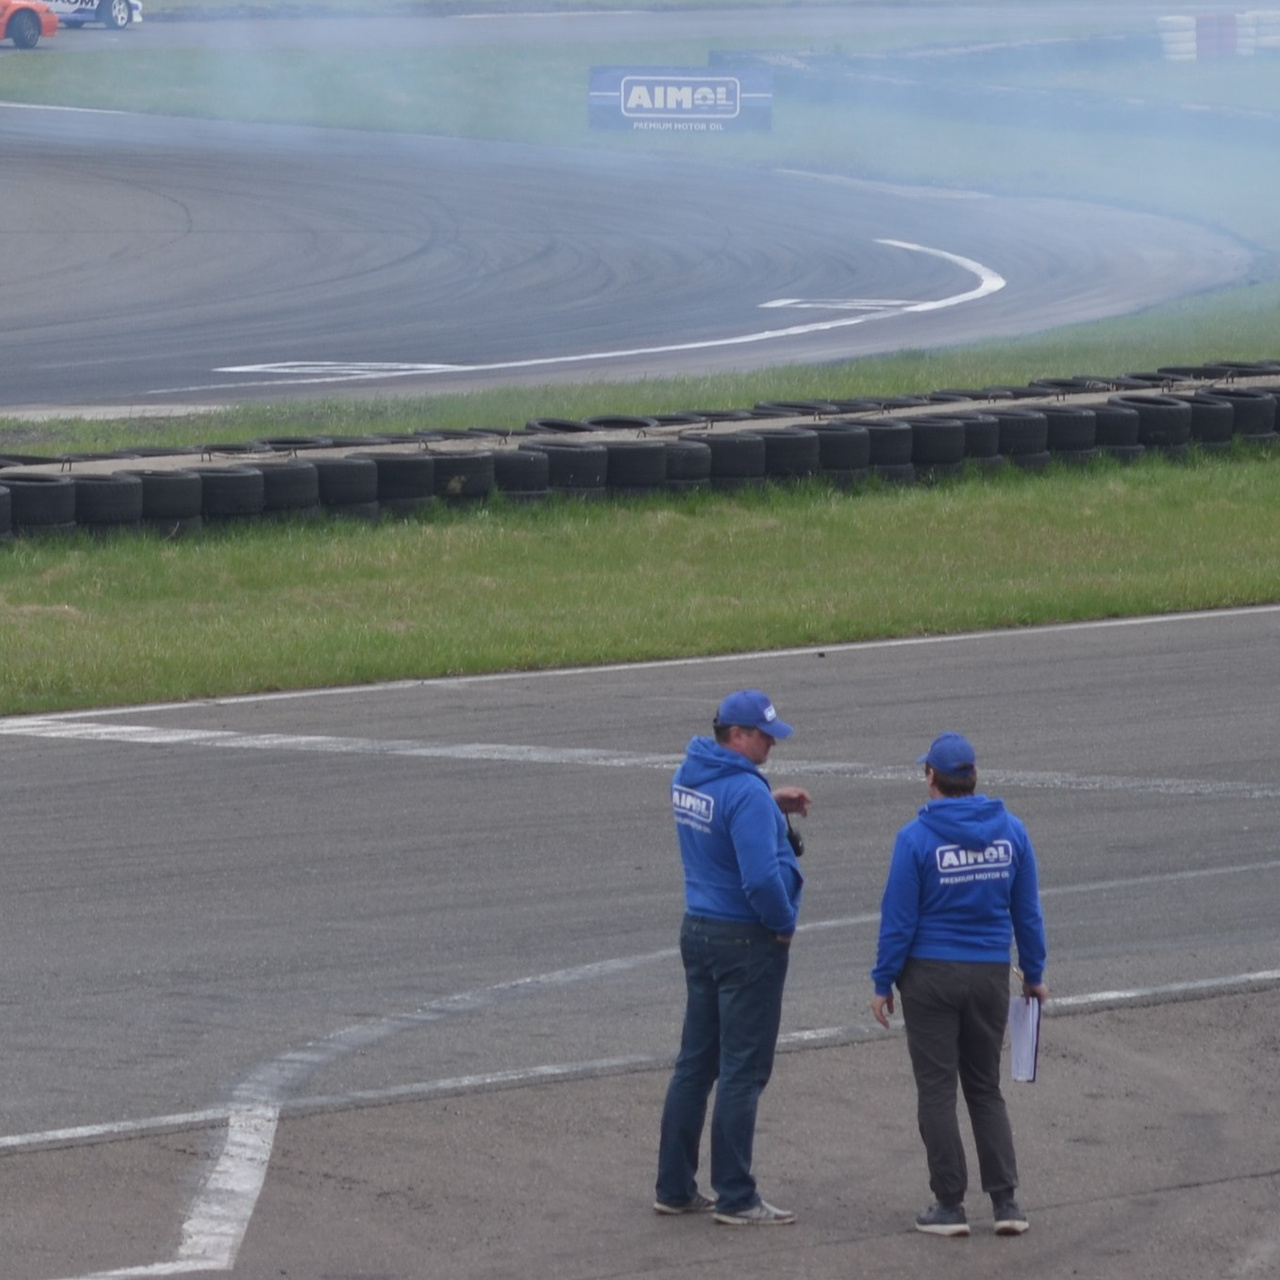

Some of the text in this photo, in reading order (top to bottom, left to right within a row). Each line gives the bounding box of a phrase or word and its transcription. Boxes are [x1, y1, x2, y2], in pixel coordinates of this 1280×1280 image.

[626, 85, 734, 109] AIMOL
[633, 122, 724, 131] PREMIUM MOTOR OIL
[941, 846, 1009, 868] AIMOL
[940, 873, 974, 885] PREMIUM
[975, 871, 1001, 881] MOTOR
